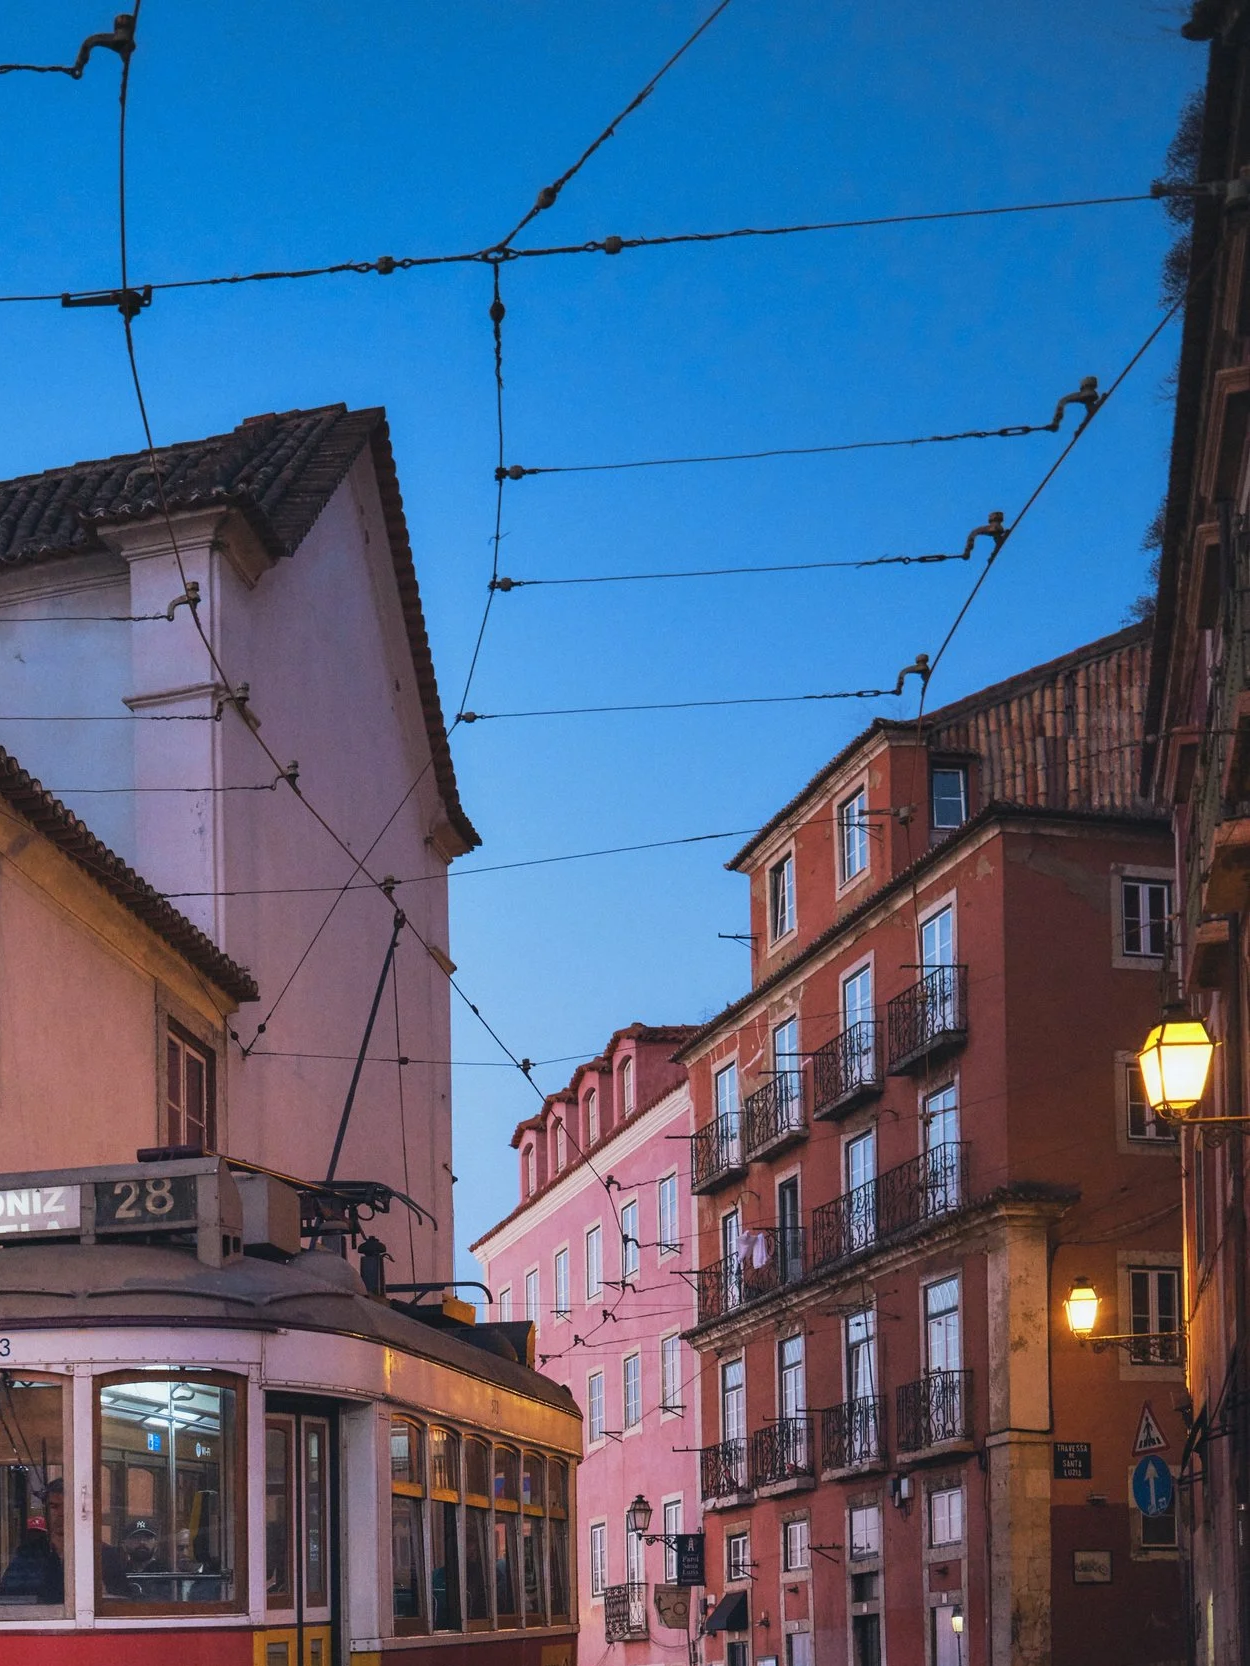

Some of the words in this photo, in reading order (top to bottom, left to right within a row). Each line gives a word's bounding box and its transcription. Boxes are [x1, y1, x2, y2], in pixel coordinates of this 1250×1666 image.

[113, 1178, 174, 1219] 28
[1057, 1444, 1088, 1453] TRAVESSA
[1062, 1460, 1082, 1468] SANTA
[1064, 1469, 1082, 1477] LUZIA
